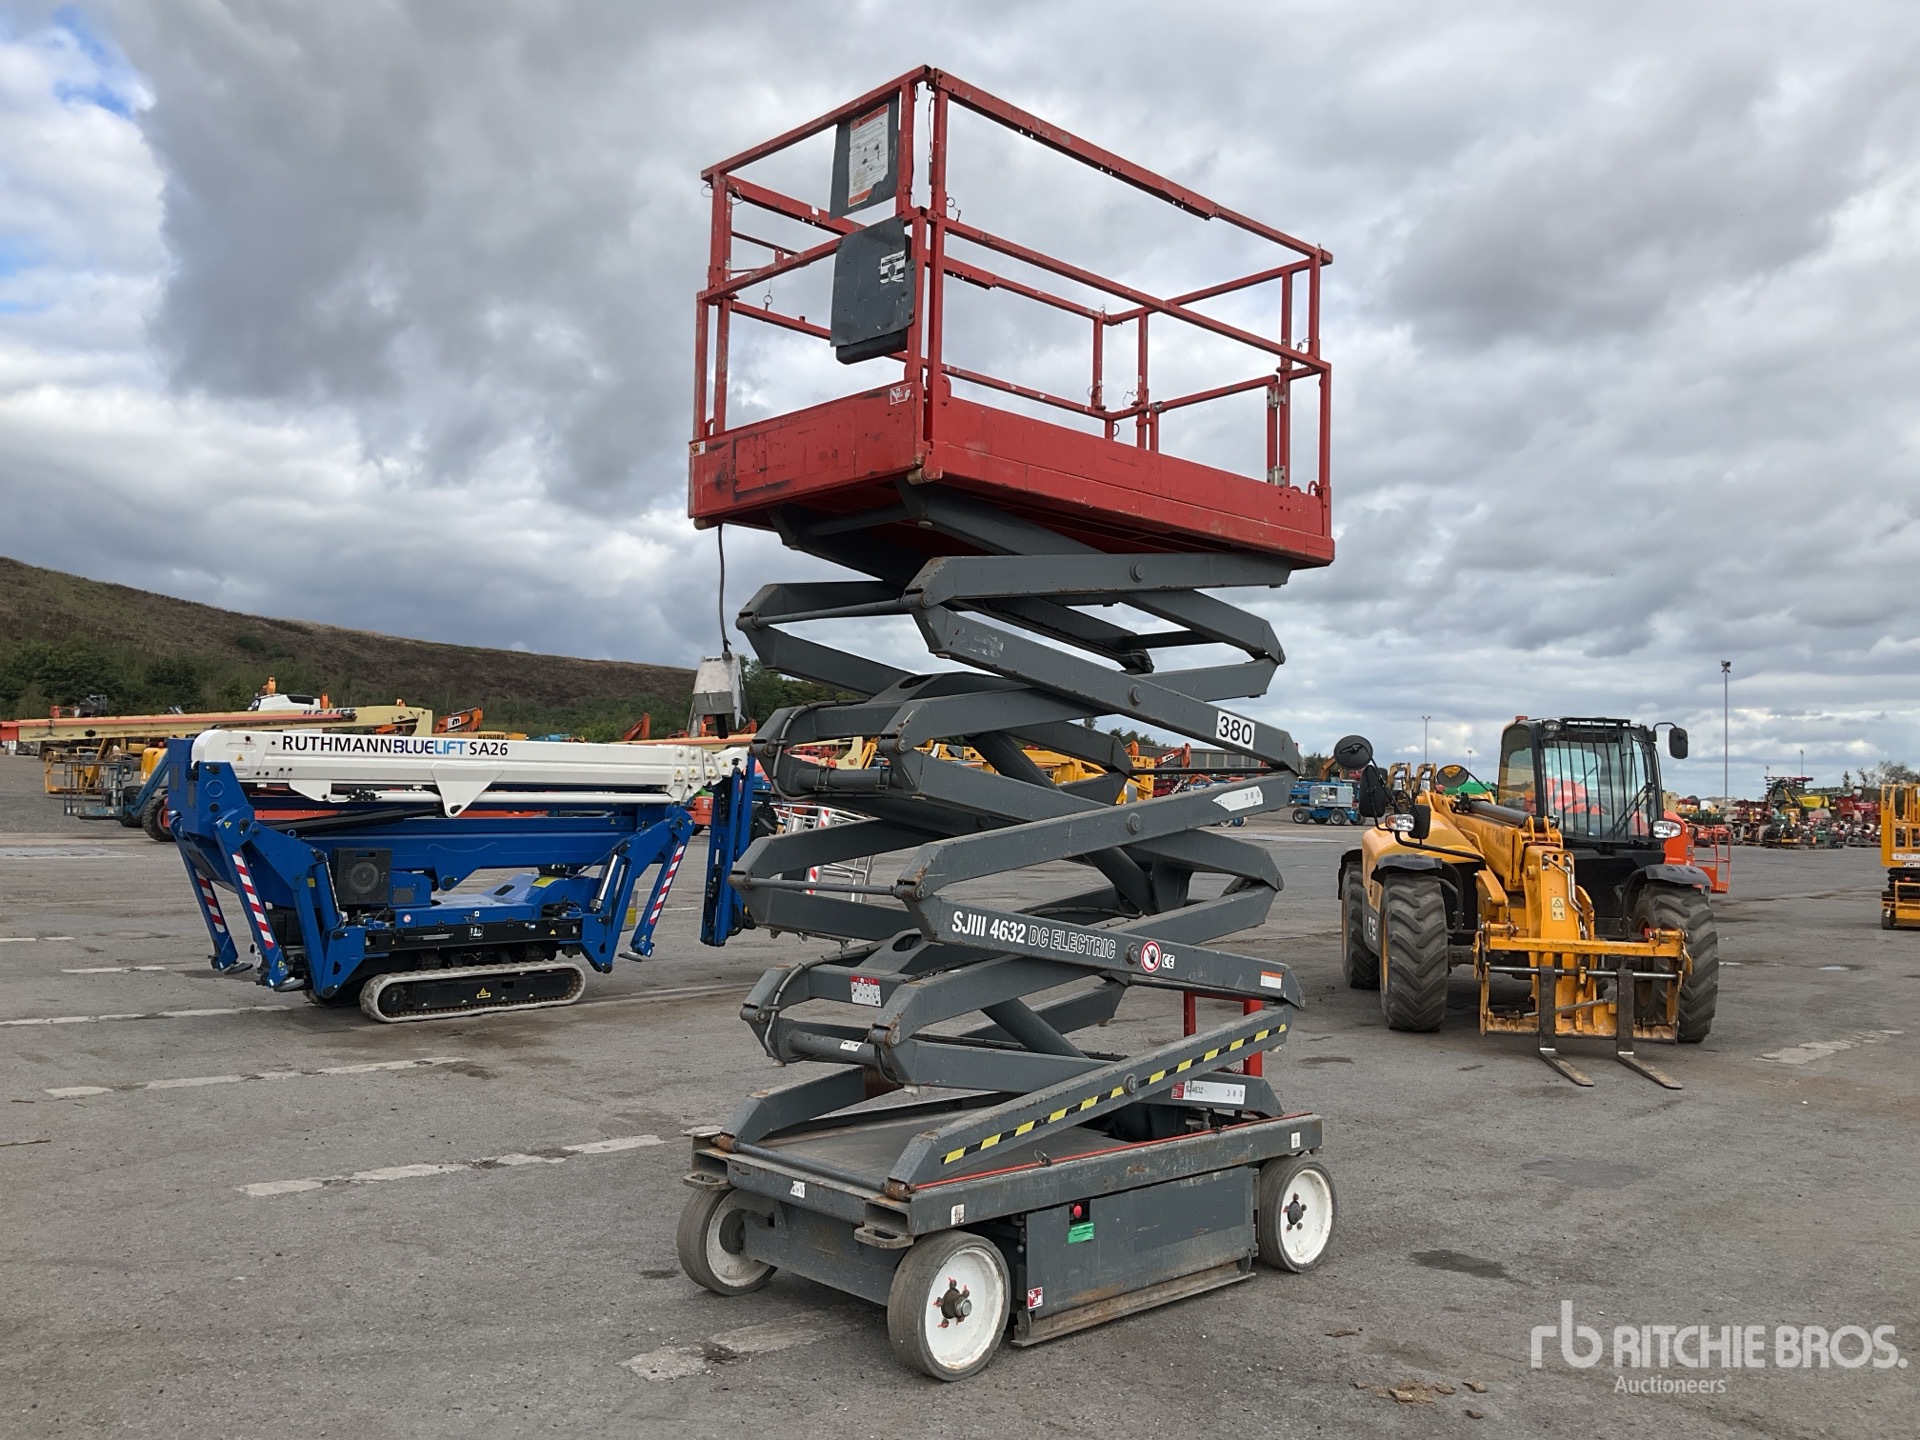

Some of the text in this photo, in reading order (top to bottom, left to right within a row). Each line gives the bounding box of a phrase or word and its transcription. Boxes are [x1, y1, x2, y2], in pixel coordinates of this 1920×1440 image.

[1219, 716, 1252, 744] 380
[469, 742, 508, 756] SA26
[989, 918, 1026, 944] 4632
[1028, 925, 1049, 949] DC
[1050, 929, 1116, 959] ELECTRIC
[1162, 953, 1175, 968] CE
